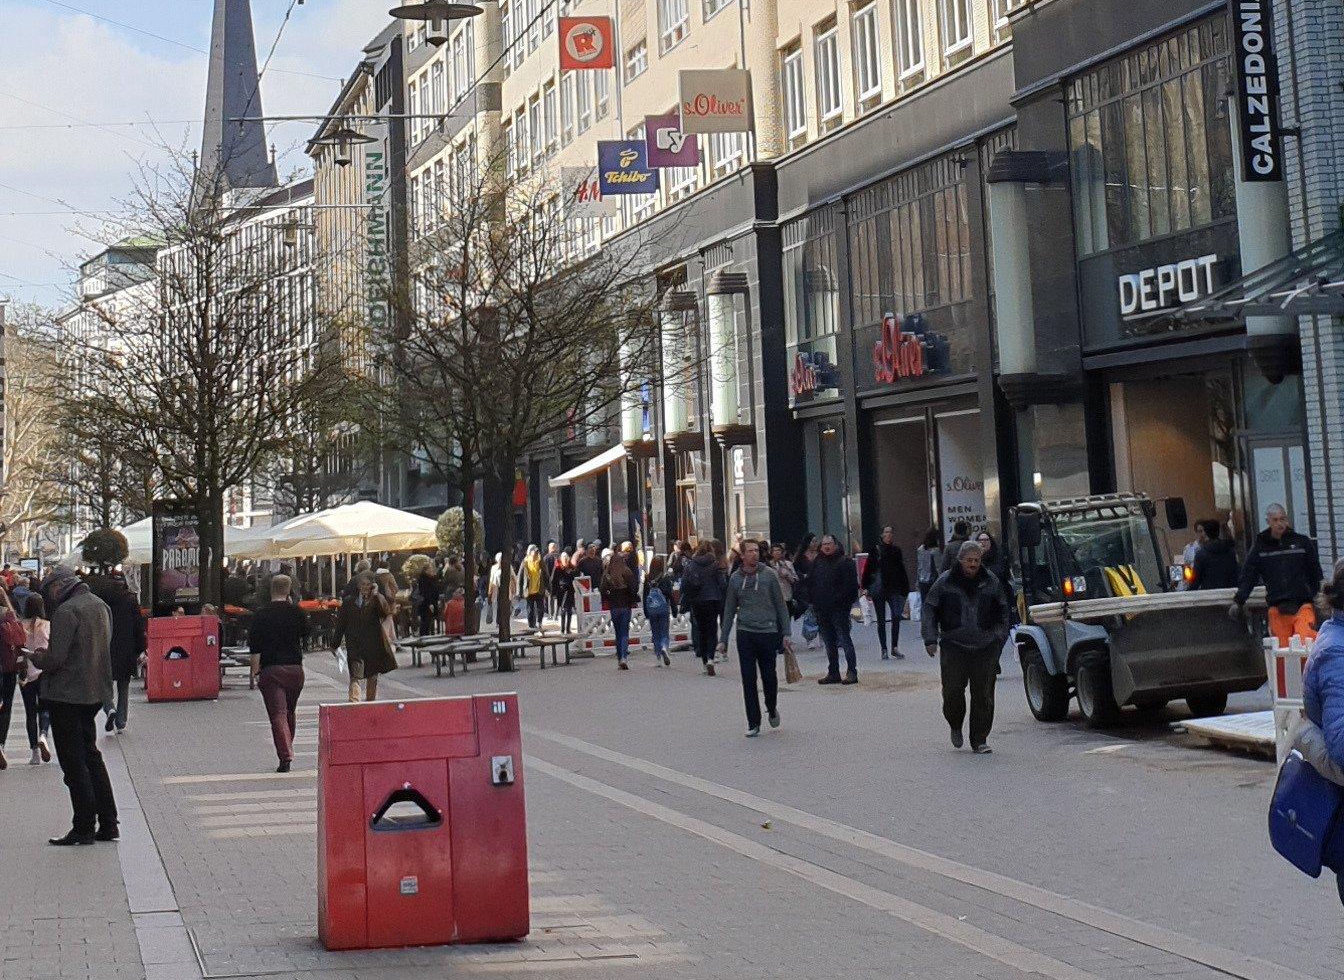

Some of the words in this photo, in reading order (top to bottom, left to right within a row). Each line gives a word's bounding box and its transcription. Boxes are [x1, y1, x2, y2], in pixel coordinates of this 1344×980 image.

[605, 168, 652, 185] Tchibo
[1119, 254, 1218, 315] DEPOT
[947, 505, 972, 514] MEN
